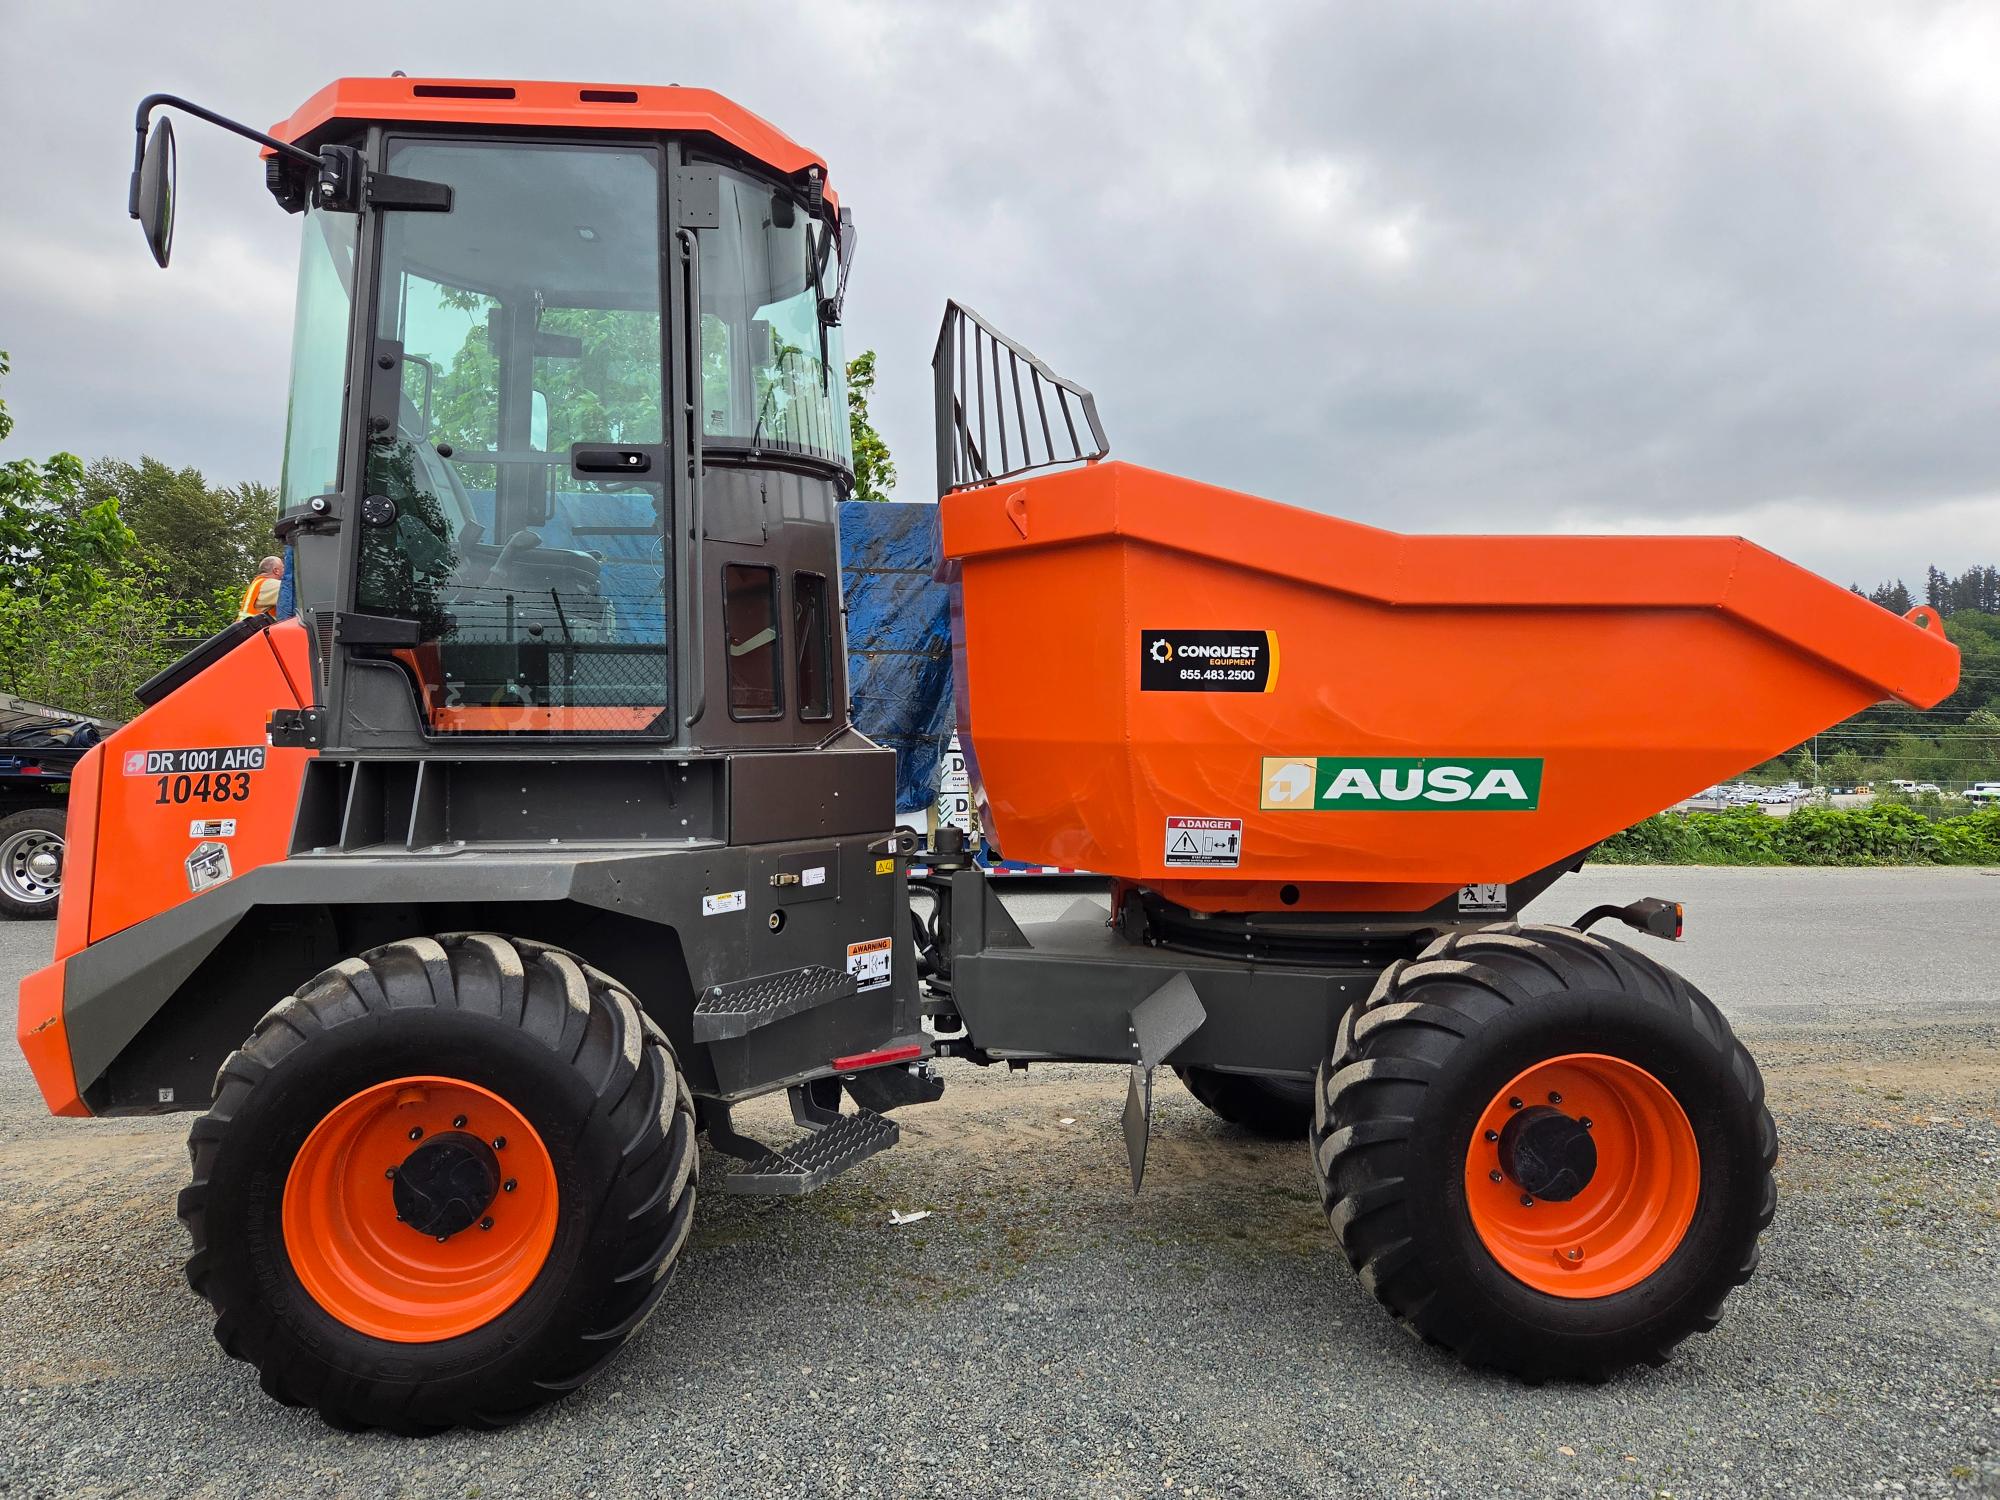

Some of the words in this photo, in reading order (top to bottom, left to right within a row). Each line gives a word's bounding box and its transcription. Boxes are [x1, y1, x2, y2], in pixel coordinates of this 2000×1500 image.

[1177, 645, 1260, 658] CONQUEST
[1209, 658, 1256, 666] EQUIPMENT
[1179, 669, 1256, 681] 855.483.2500
[147, 752, 174, 773] DR
[179, 750, 218, 771] 1001
[221, 748, 263, 769] AHG
[155, 772, 251, 805] 10483
[1322, 766, 1529, 802] AUSA
[1187, 820, 1232, 829] DANGER
[857, 940, 887, 953] WARNING
